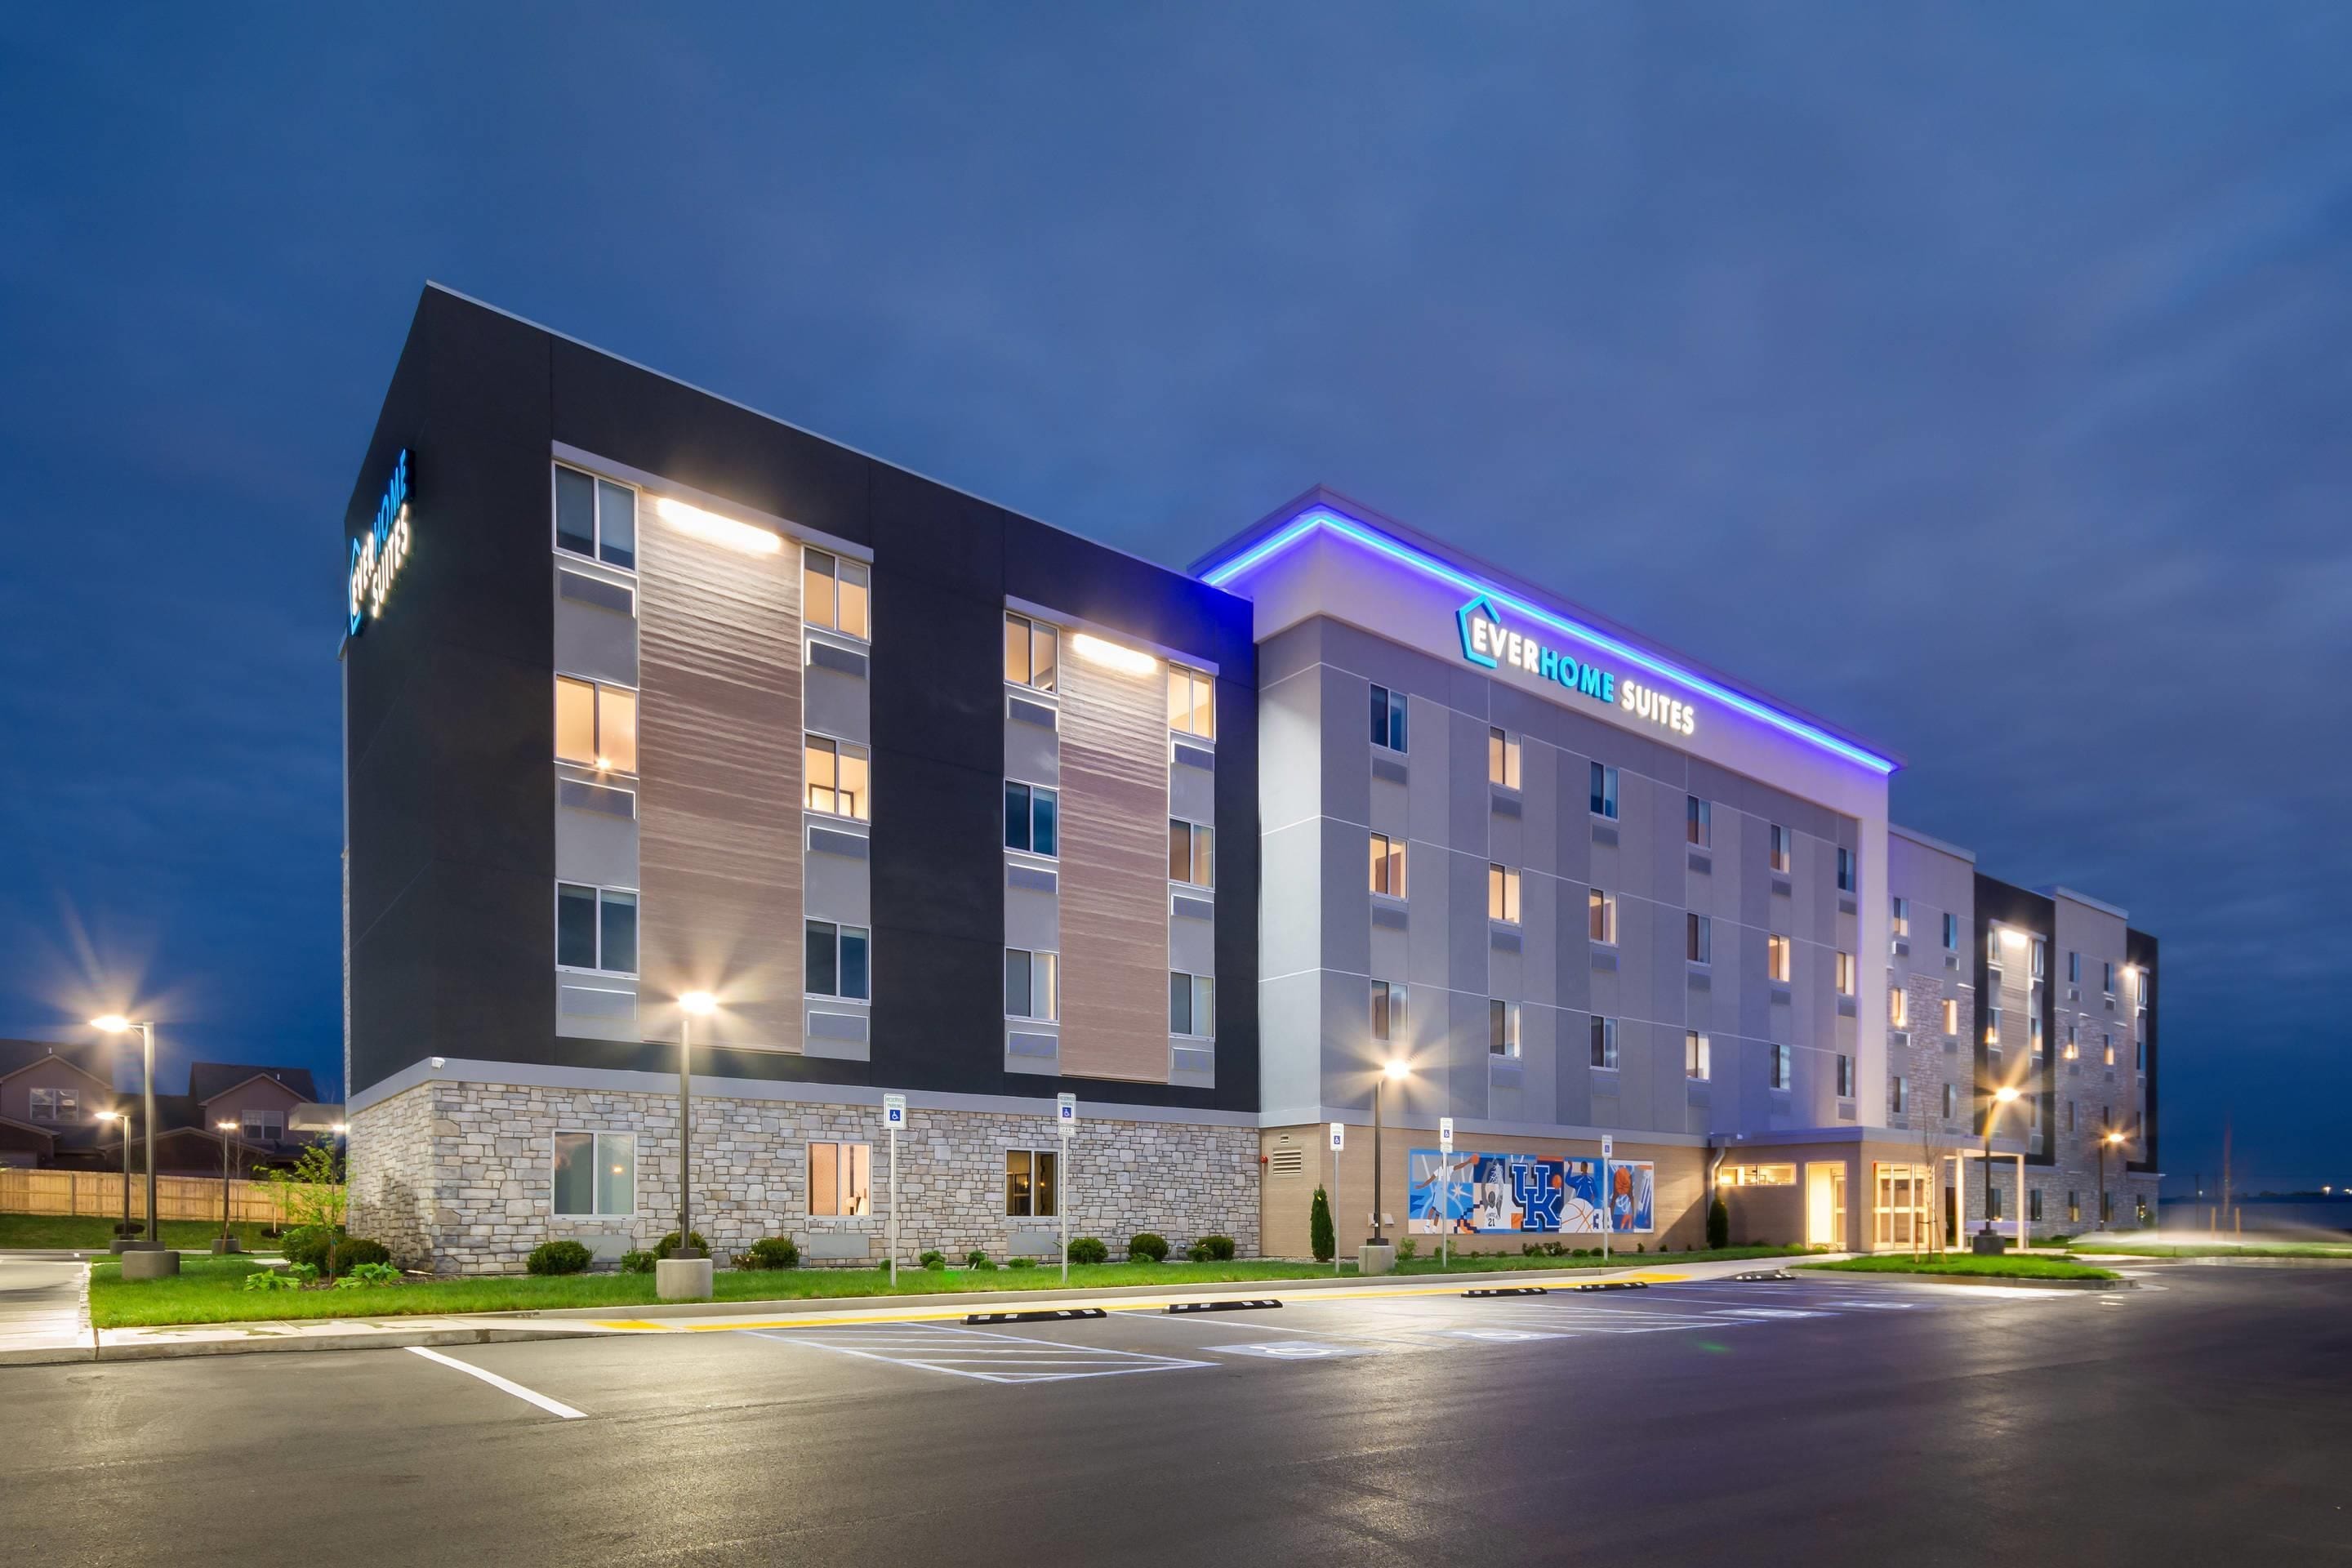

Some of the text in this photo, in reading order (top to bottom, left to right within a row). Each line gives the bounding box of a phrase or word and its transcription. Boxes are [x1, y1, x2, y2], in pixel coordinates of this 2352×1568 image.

[351, 448, 406, 617] EVERHOME
[371, 503, 409, 619] SUITES
[1472, 617, 1695, 735] EVERHOME SUITES
[1488, 1217, 1496, 1227] 21
[1511, 1163, 1562, 1229] UK
